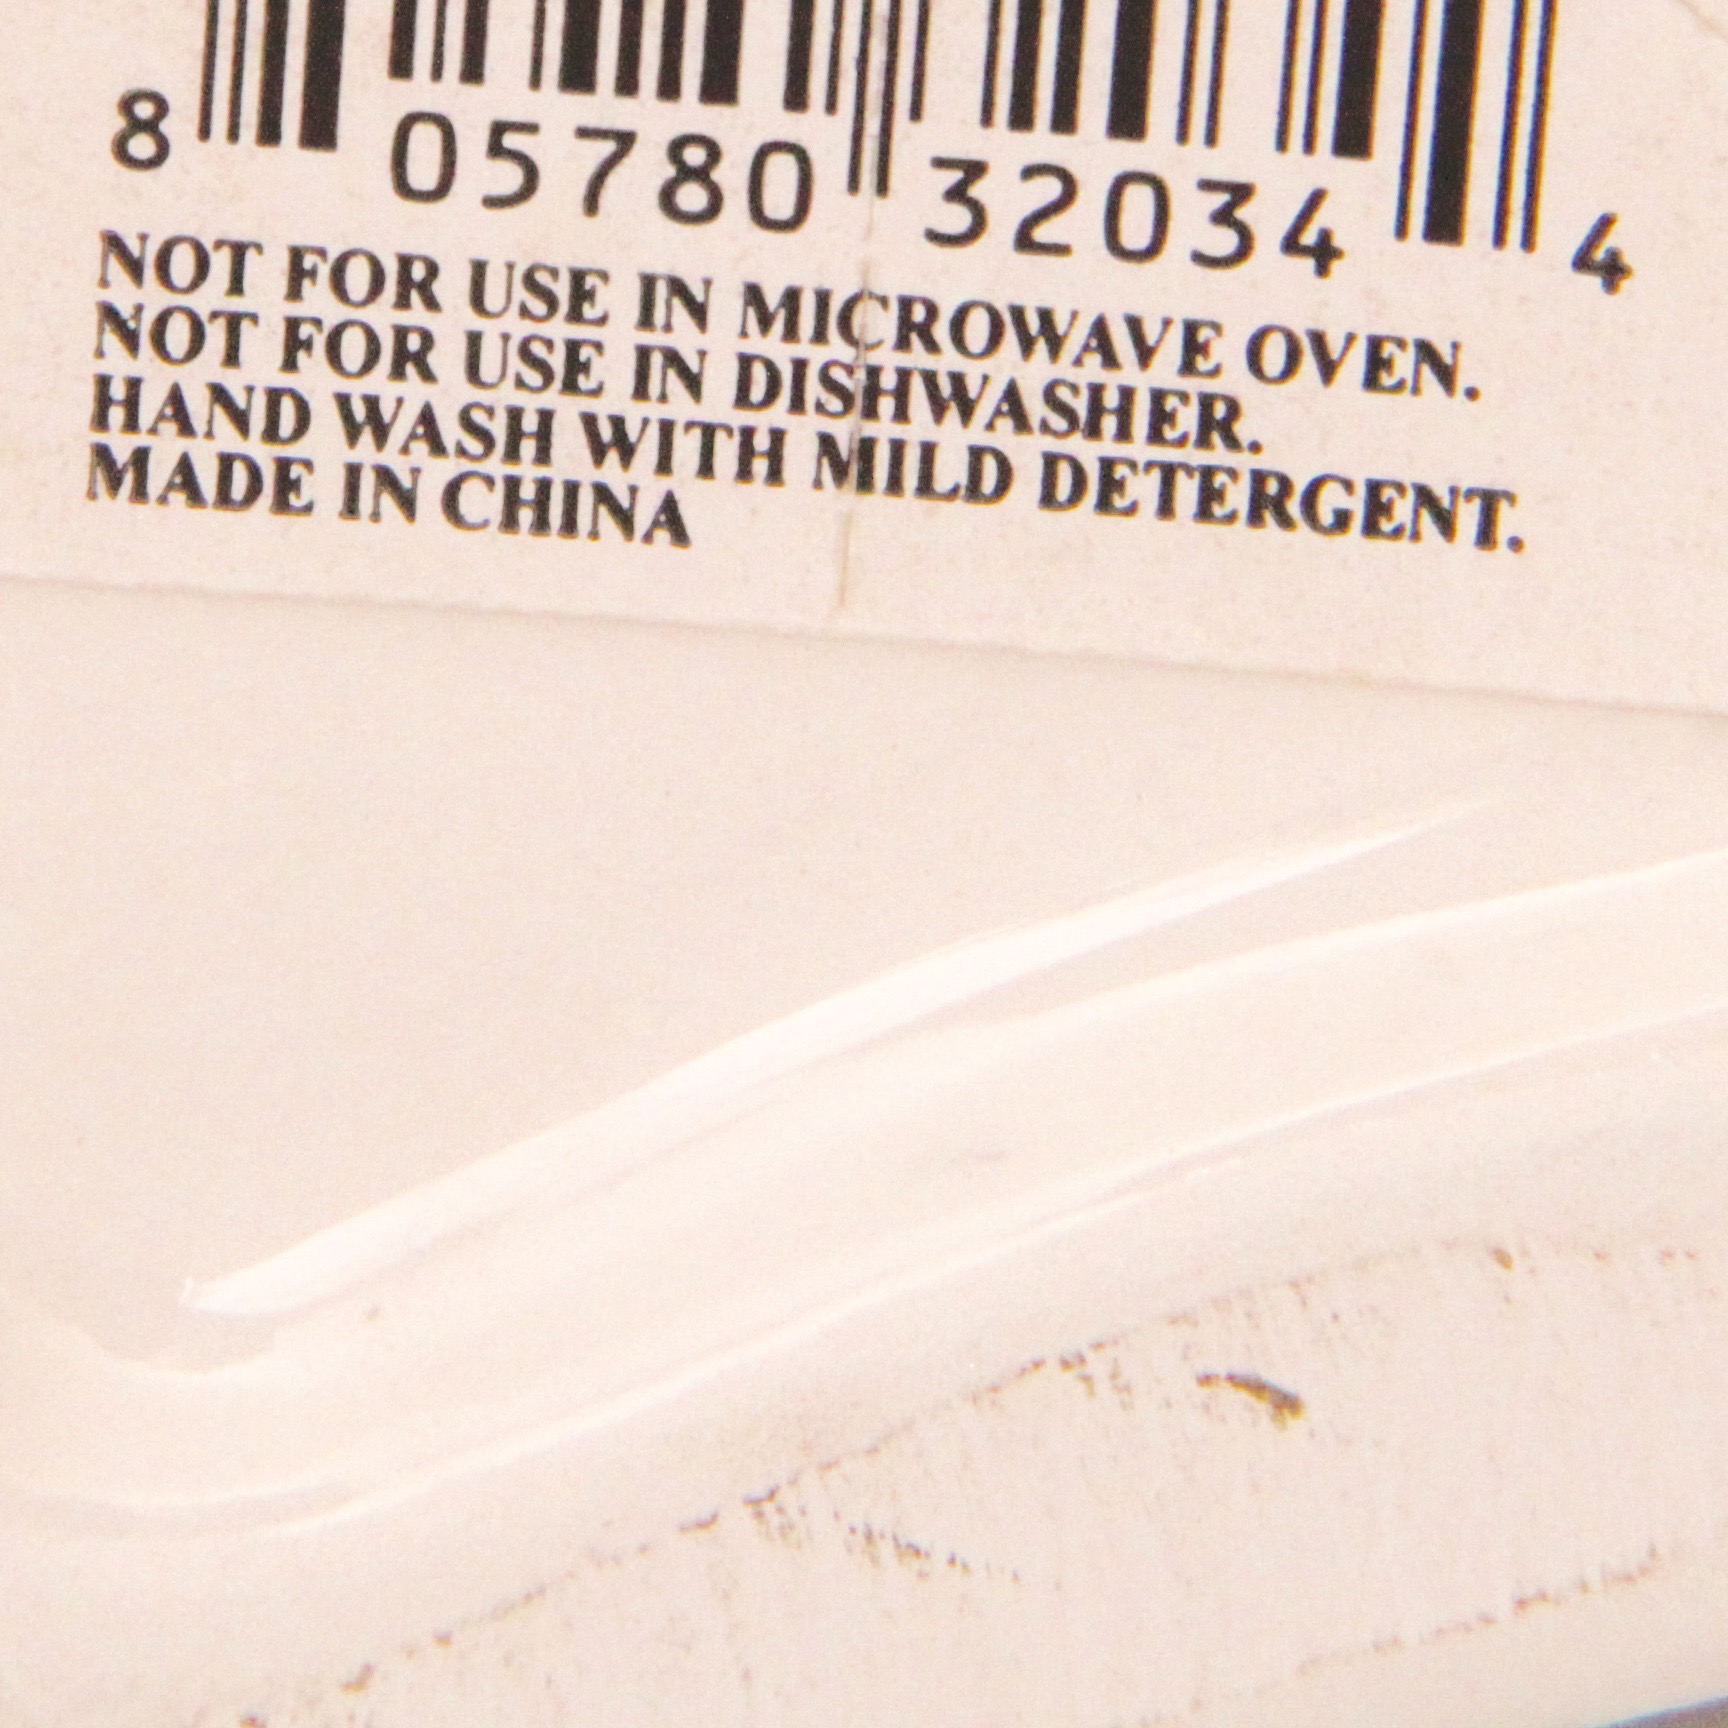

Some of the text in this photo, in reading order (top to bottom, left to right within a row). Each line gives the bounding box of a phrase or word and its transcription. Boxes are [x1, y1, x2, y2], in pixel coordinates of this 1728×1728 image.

[111, 88, 1632, 295] 8 05780 32034 4
[97, 300, 1263, 455] NOT FOR USE IN DISHWASHER.
[100, 229, 1480, 402] NOT FOR USE IN MICROWAVE OVEN.
[86, 441, 691, 549] MADE IN CHINA
[90, 372, 1524, 553] HAND WASH WITH MILD DETERGENT.
